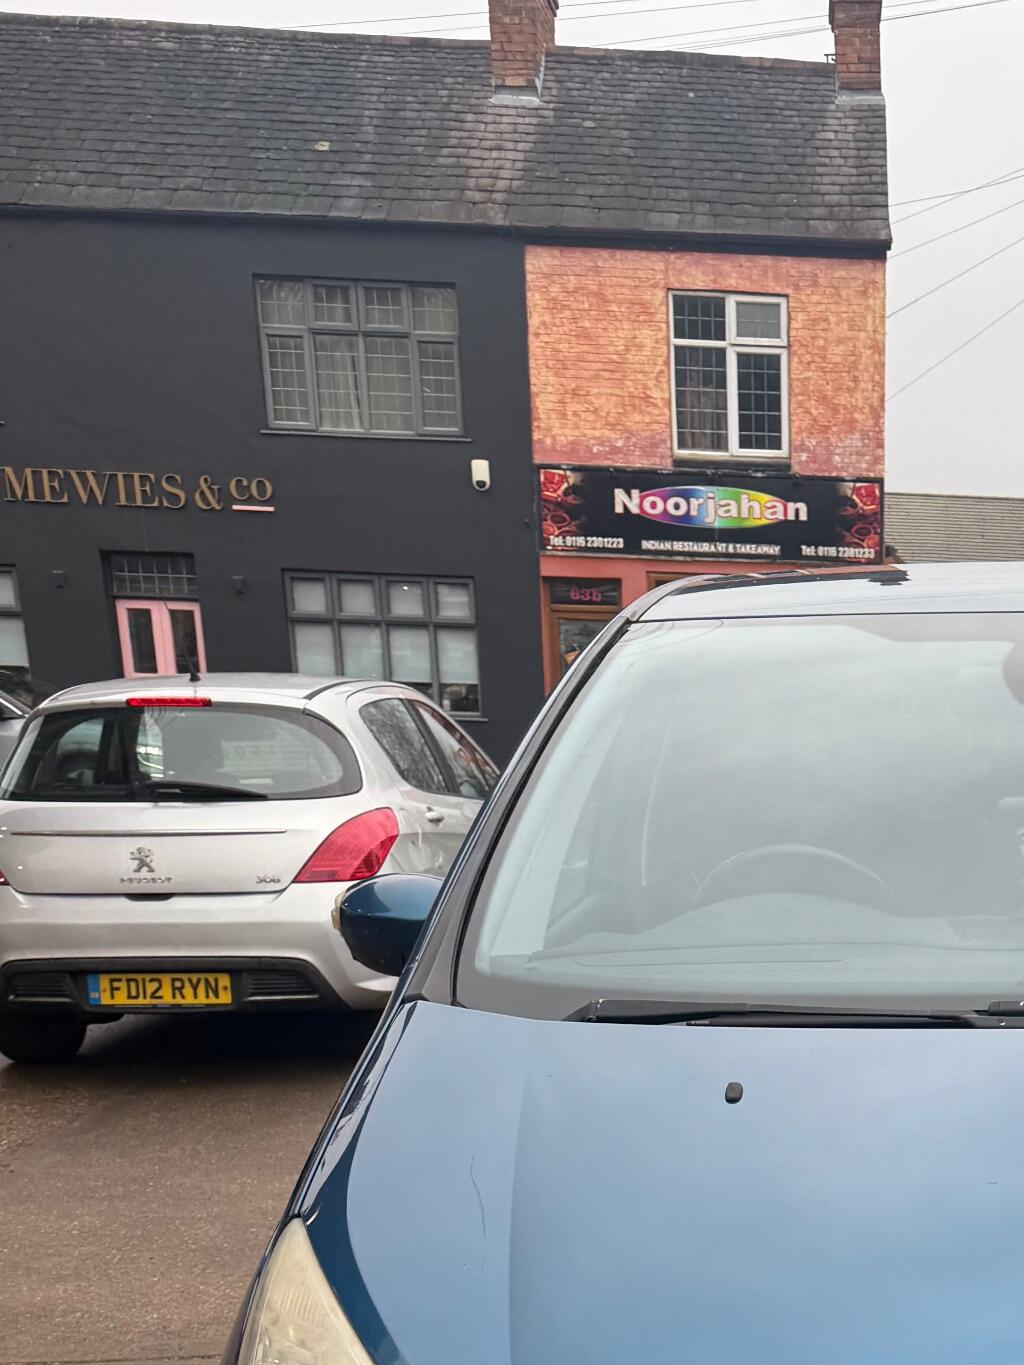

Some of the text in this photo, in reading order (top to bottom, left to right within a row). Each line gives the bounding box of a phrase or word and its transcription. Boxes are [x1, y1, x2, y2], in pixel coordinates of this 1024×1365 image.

[0, 466, 187, 509] MEWIES
[194, 475, 223, 510] &
[613, 487, 808, 522] Noorjahan
[641, 539, 672, 551] INDIAN
[673, 541, 727, 553] RESTAURANT
[736, 543, 781, 555] TAKEAWAY
[108, 976, 220, 1001] FD12 RYN
